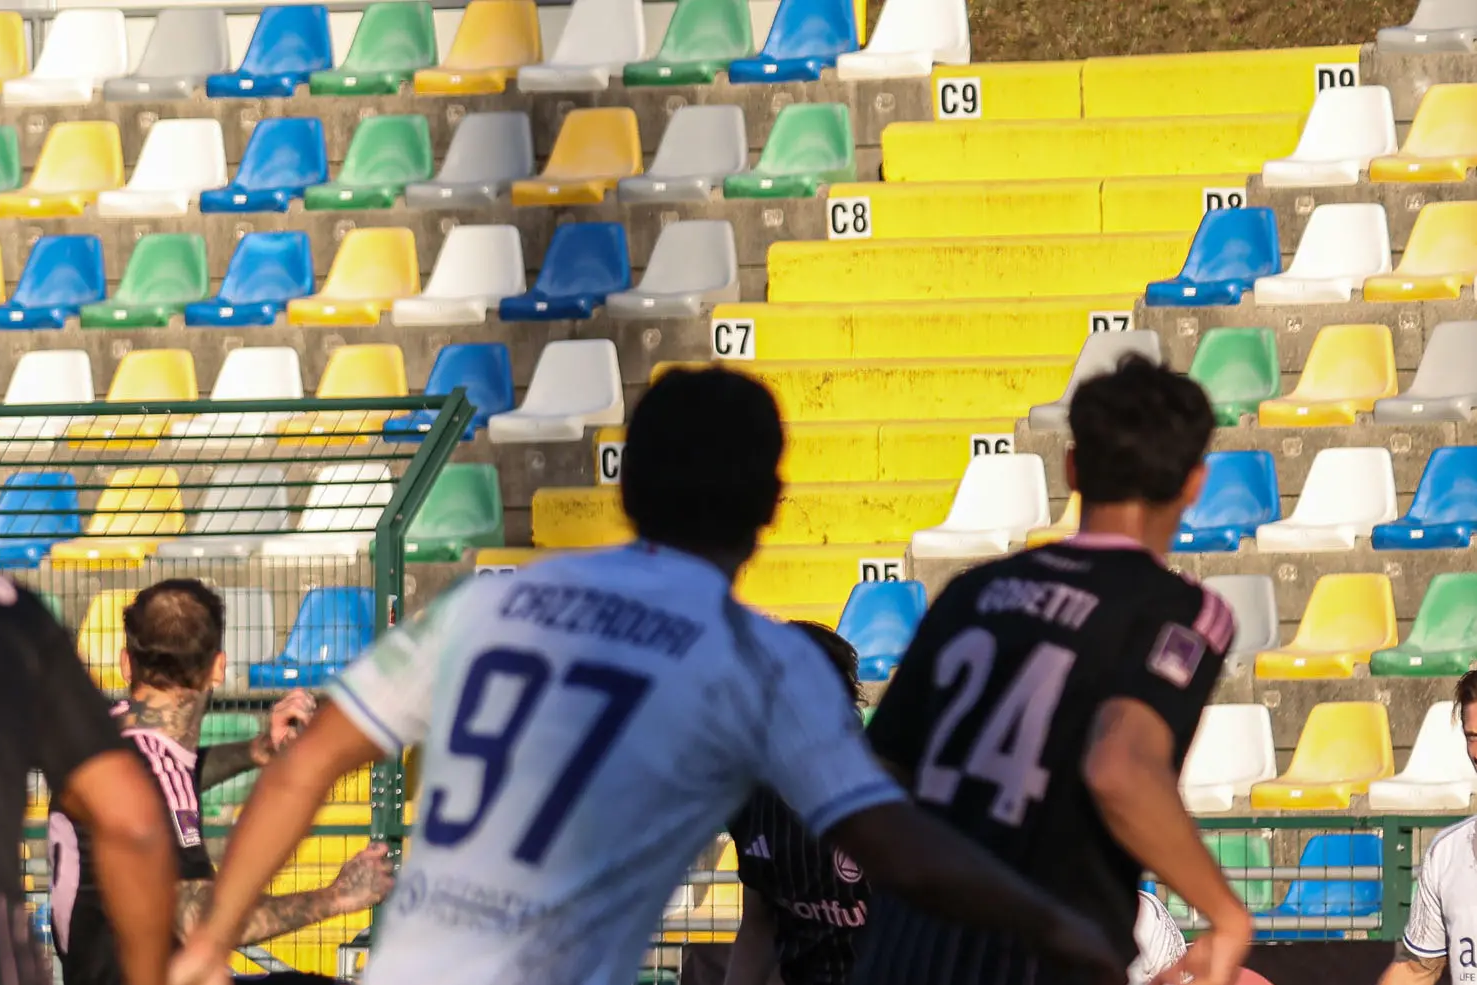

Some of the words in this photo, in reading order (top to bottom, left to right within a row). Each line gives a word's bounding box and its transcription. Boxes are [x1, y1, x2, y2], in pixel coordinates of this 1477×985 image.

[941, 83, 977, 114] C9
[831, 203, 867, 234] C8
[715, 324, 750, 355] C7
[602, 447, 623, 479] C
[917, 627, 1079, 827] 24
[423, 645, 657, 867] 97
